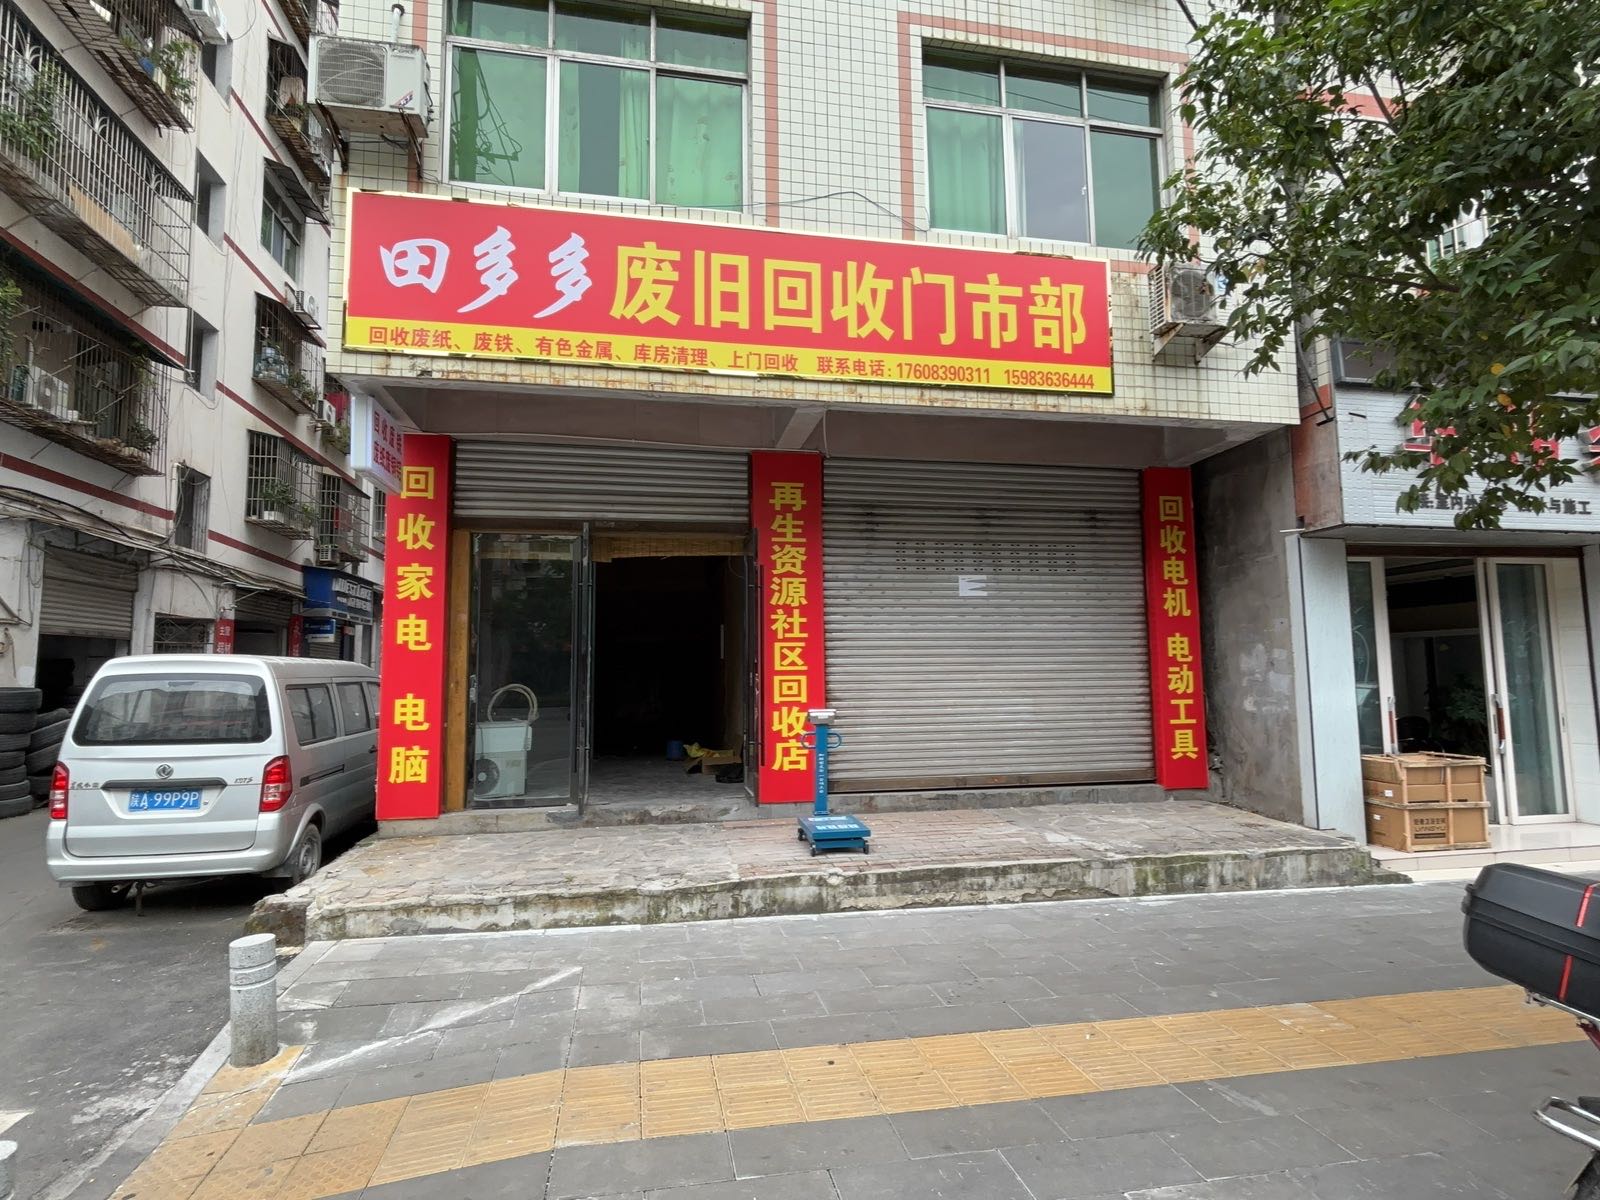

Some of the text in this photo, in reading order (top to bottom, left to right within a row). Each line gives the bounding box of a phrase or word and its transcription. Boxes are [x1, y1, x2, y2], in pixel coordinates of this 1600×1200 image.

[379, 225, 1087, 355] 田多多 废旧回收门市部
[1003, 369, 1095, 390] 15983636444
[768, 481, 809, 771] 再生资源社区回收店
